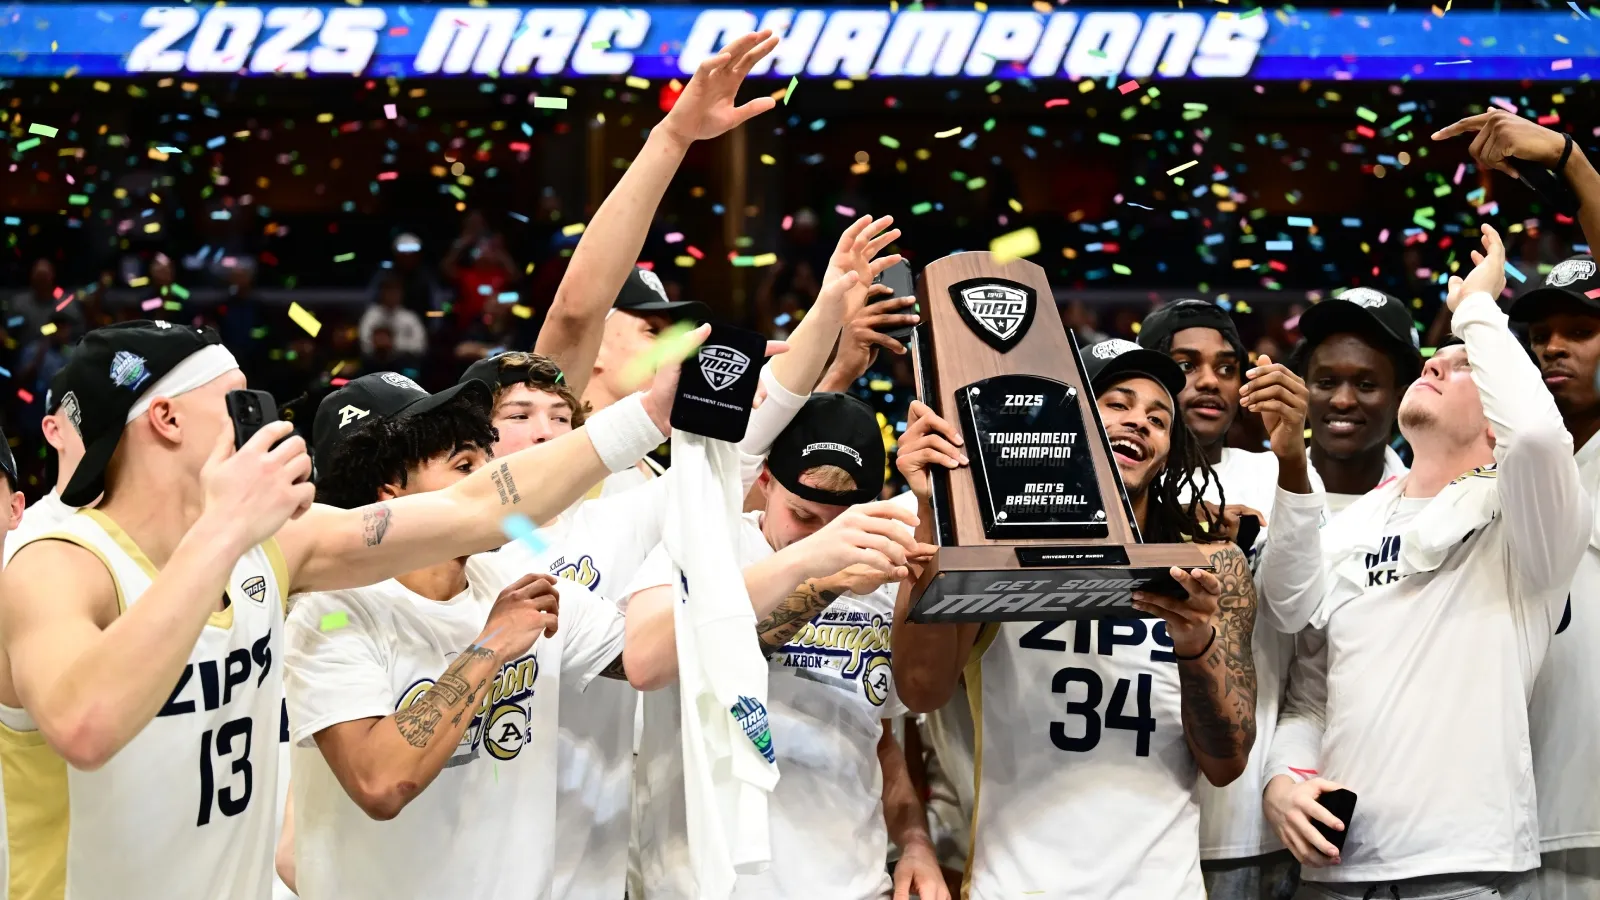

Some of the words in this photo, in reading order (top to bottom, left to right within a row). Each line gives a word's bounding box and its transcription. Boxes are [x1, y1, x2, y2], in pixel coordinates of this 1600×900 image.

[126, 6, 387, 73] 2025
[413, 7, 651, 74] MAC
[678, 8, 1268, 77] CHAMPIONS
[972, 302, 1025, 316] MAC
[699, 356, 744, 376] MAC
[683, 393, 717, 405] TOURNAMENT
[717, 401, 744, 412] CHAMPION
[1004, 394, 1044, 407] 2025
[338, 404, 370, 430] A
[988, 432, 1078, 444] TOURNAMENT
[1001, 446, 1072, 459] CHAMPION
[1024, 483, 1064, 493] MEN'S
[1005, 495, 1088, 506] BASKETBALL
[244, 581, 265, 596] MAC
[984, 579, 1051, 592] GET
[1056, 578, 1151, 590] SOME
[922, 591, 1133, 615] MACTI
[822, 612, 847, 621] MEN'S
[1019, 618, 1178, 663] ZIPS
[783, 653, 823, 669] AKRON
[156, 628, 272, 717] ZIPS
[873, 672, 889, 693] A
[1050, 667, 1156, 757] 34
[498, 722, 523, 743] A
[197, 717, 253, 827] 13
